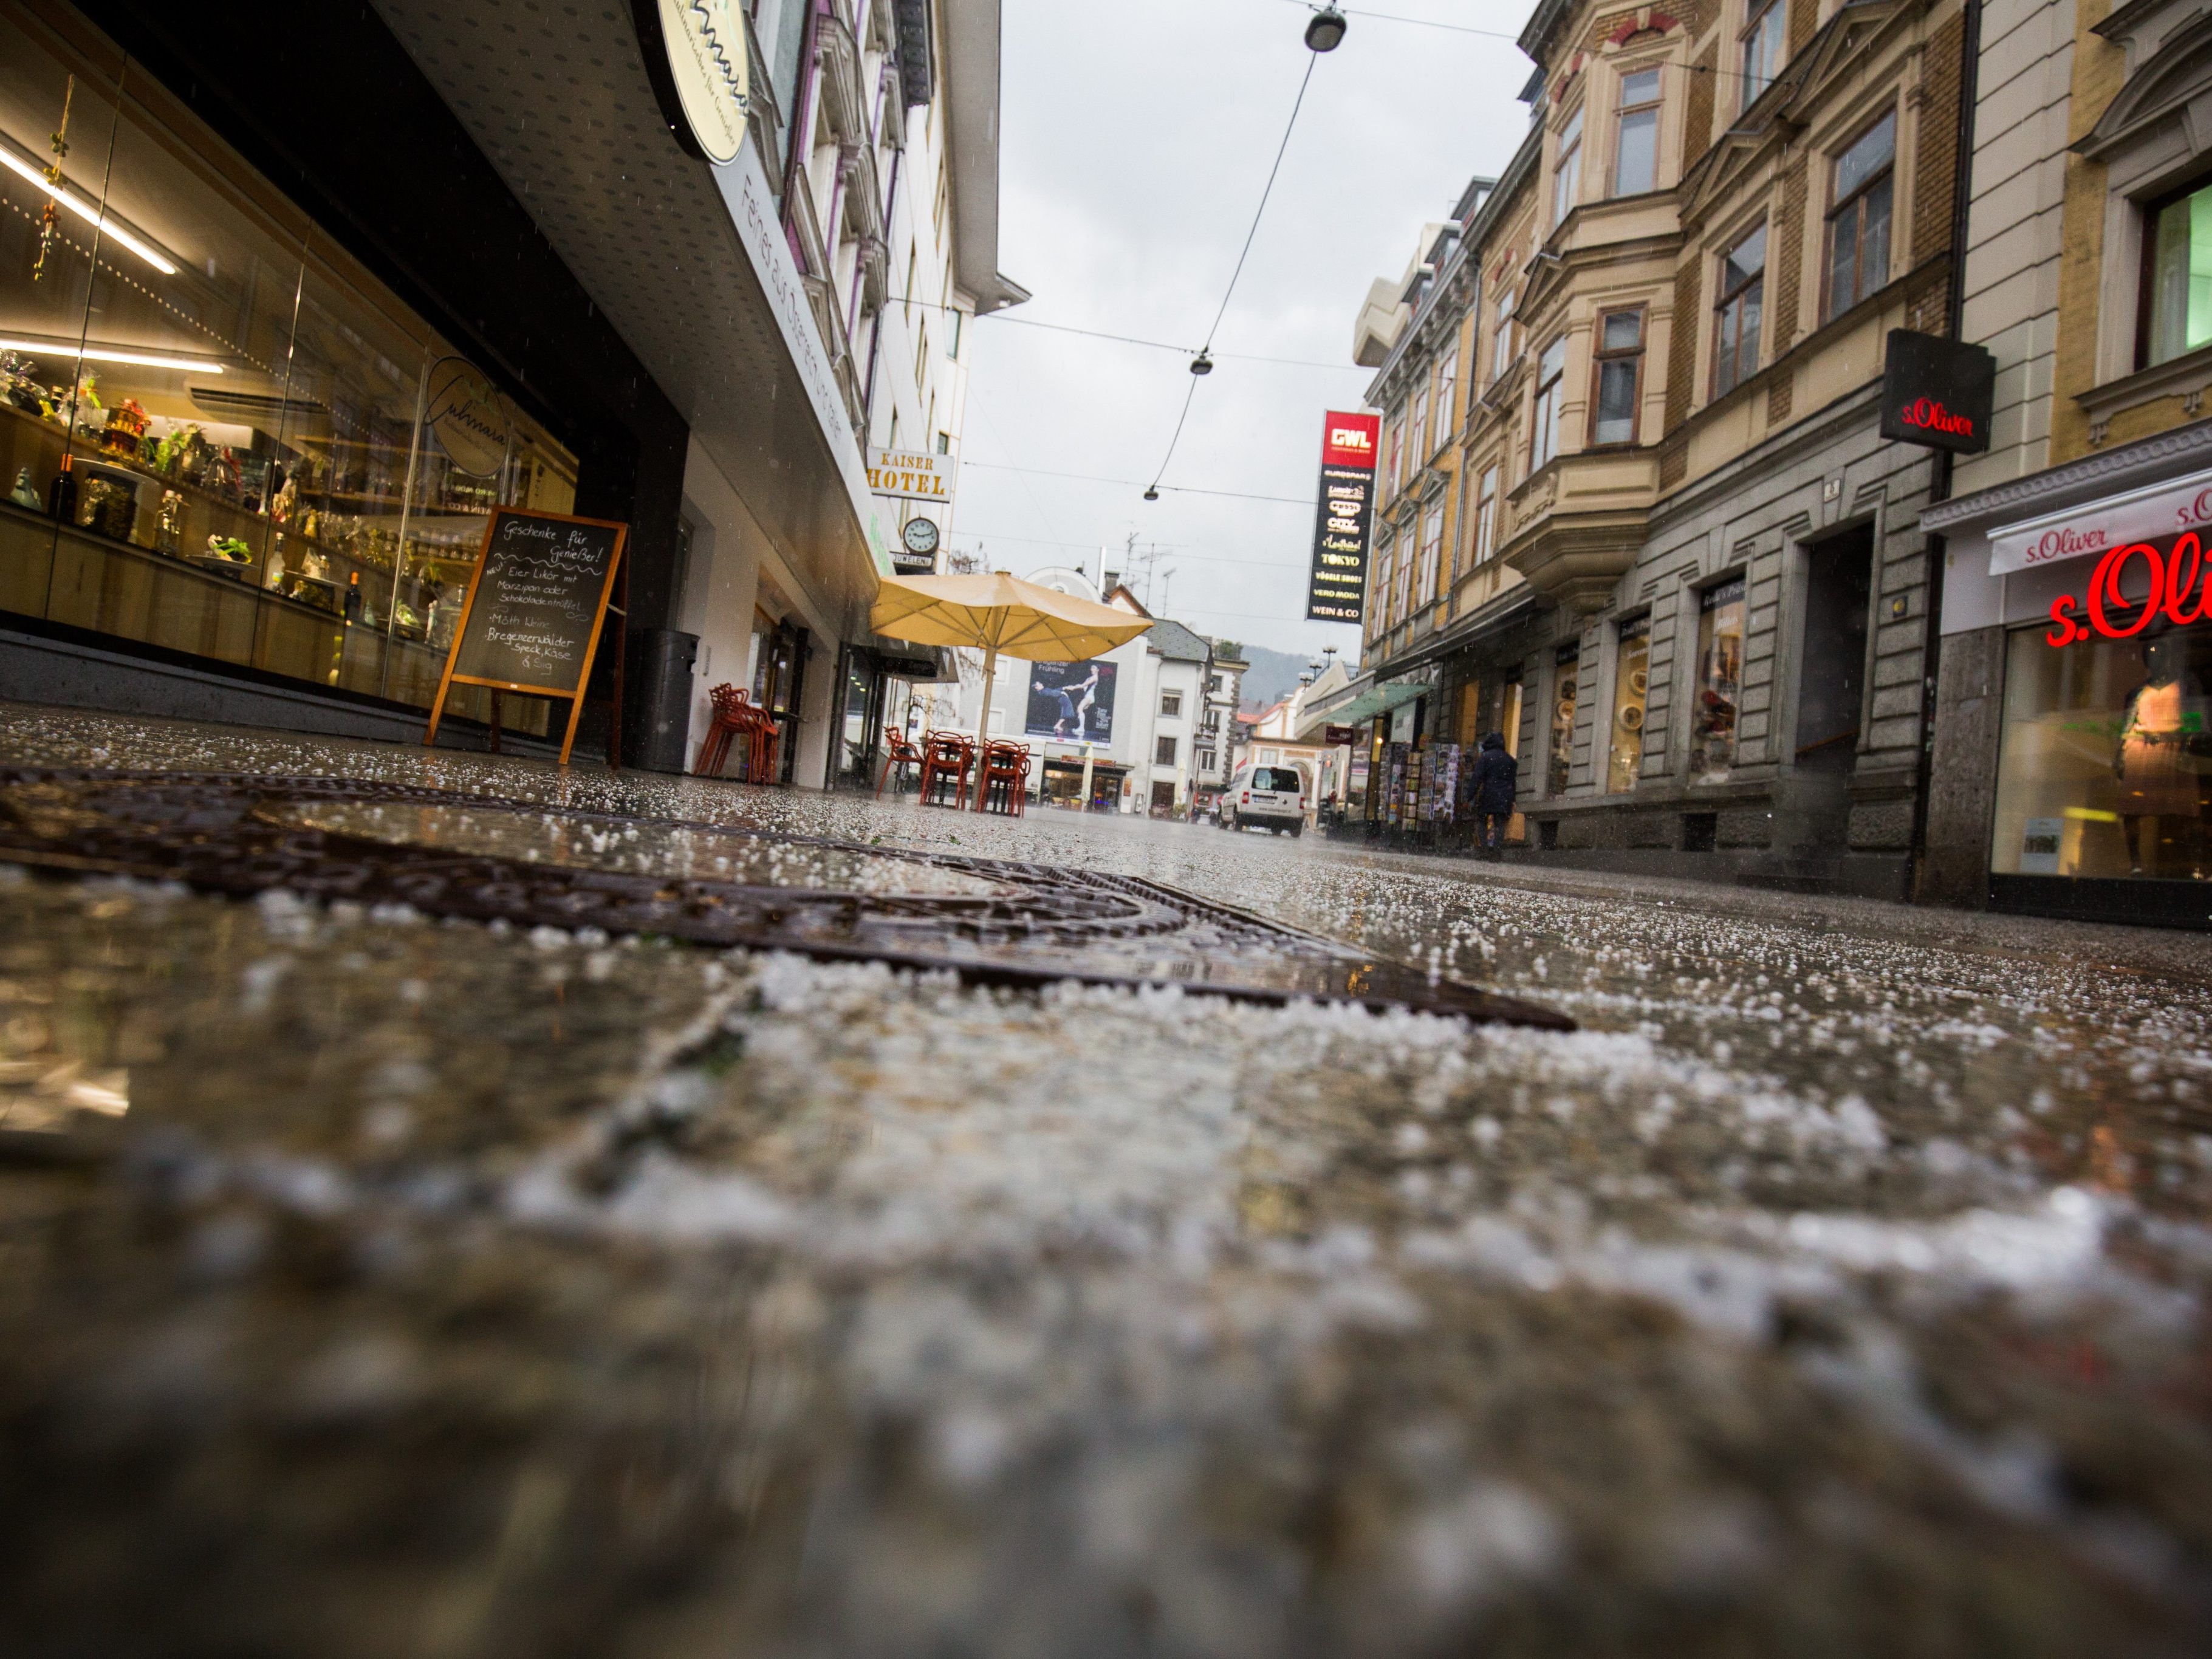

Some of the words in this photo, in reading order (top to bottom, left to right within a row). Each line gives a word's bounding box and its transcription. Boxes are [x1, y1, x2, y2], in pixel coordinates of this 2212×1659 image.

[673, 0, 706, 78] ulinarisches
[704, 74, 716, 97] für
[741, 174, 771, 269] Feines
[771, 258, 786, 304] aus
[1902, 396, 1973, 437] s.Oliver
[1331, 428, 1371, 449] GWL
[882, 453, 934, 471] KAISER
[867, 468, 945, 496] HOTEL
[504, 521, 556, 540] Geschenke
[567, 530, 588, 548] für
[2025, 527, 2108, 563] s.Oliver
[550, 546, 603, 563] Genießer!
[894, 553, 925, 565] JUWELEN
[1321, 553, 1360, 567] TOKYO
[508, 566, 530, 577] Eier
[1315, 570, 1341, 582] VÖGELE
[1342, 574, 1362, 583] SHOES
[497, 580, 540, 594] Marzipan
[543, 585, 569, 595] oder
[1313, 588, 1335, 597] VERO
[1335, 590, 1360, 600] MODA
[1312, 606, 1336, 616] WEIN
[1336, 607, 1344, 617] &
[1344, 609, 1360, 618] CO
[487, 627, 575, 648] Bregenzerwälder
[1038, 664, 1065, 675] Frühling
